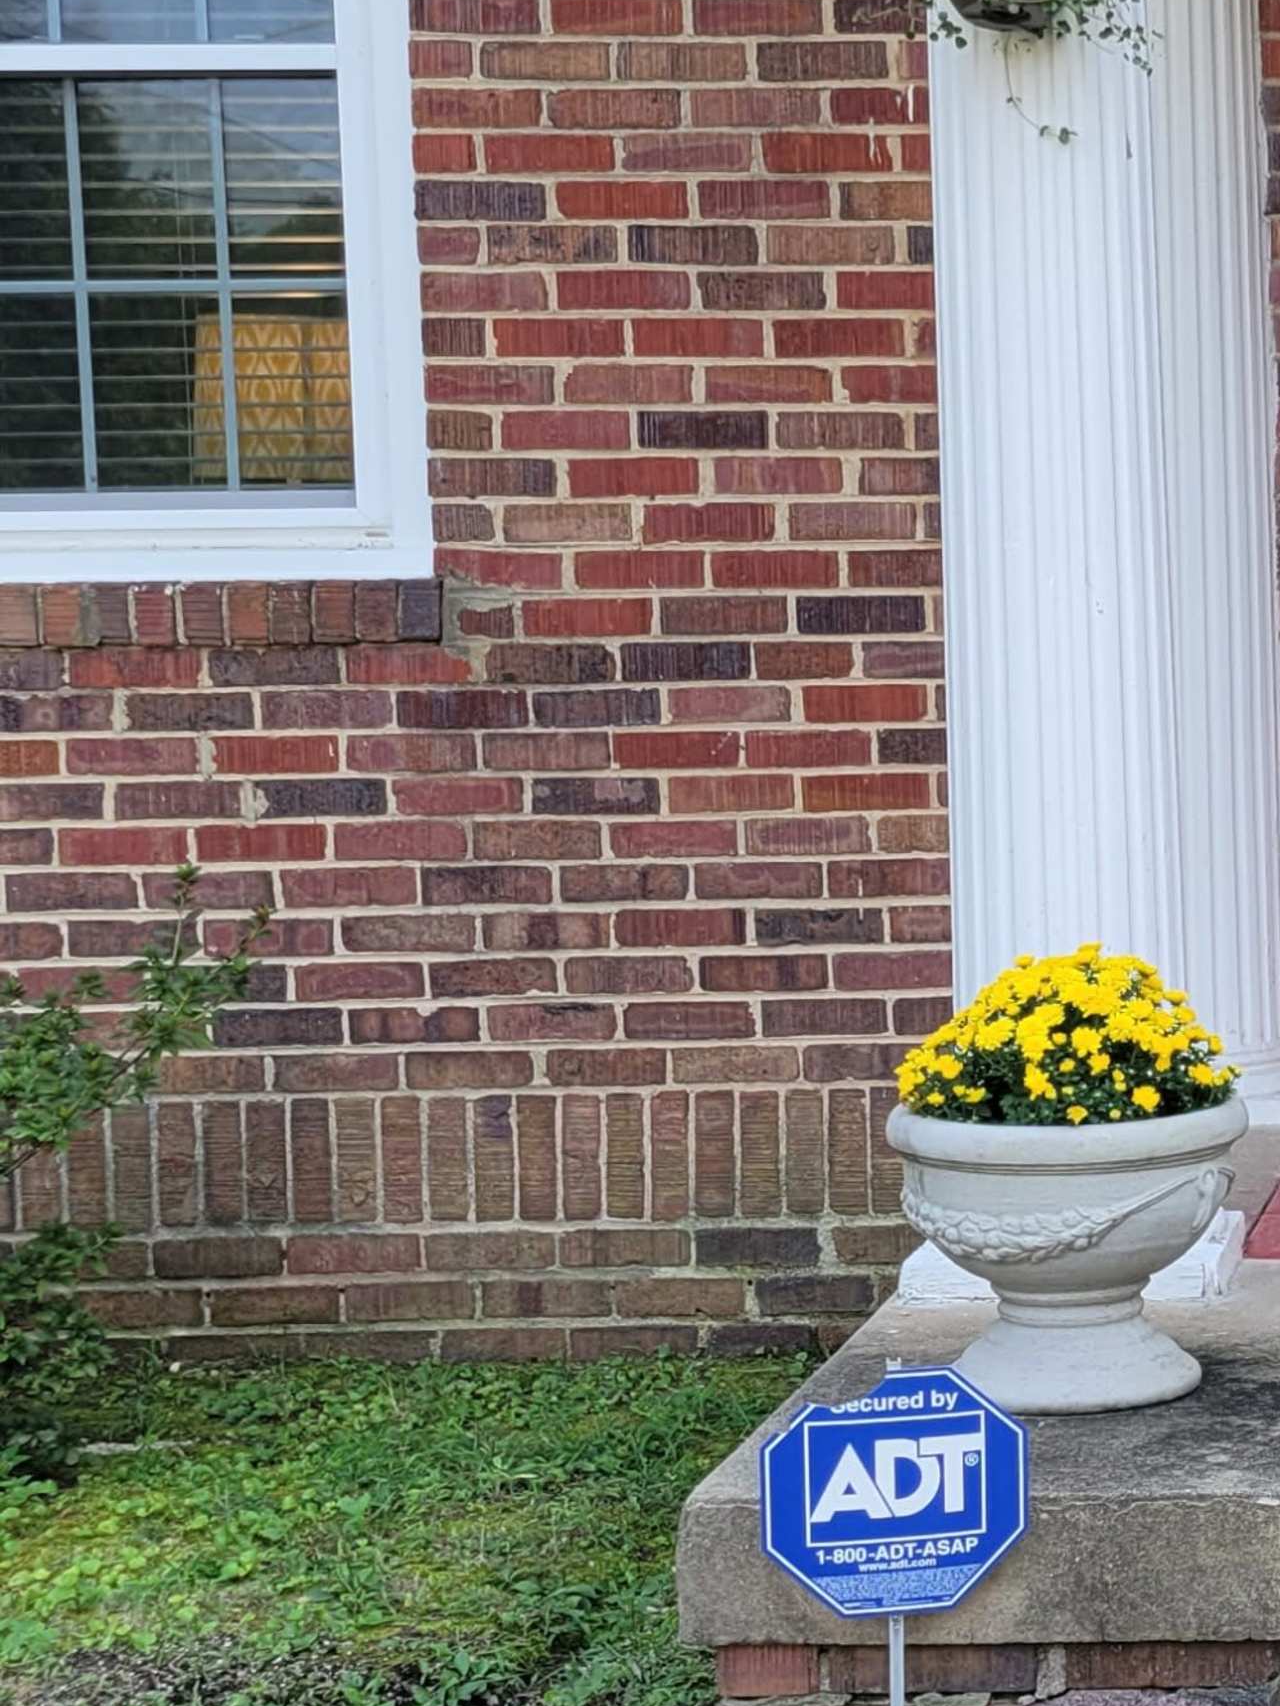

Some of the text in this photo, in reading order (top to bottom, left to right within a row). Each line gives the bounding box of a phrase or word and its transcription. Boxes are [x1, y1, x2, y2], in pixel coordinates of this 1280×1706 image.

[930, 1389, 958, 1412] by
[815, 1536, 979, 1565] 1-800-ADT-ASAP
[858, 1557, 937, 1573] www.adt.com
